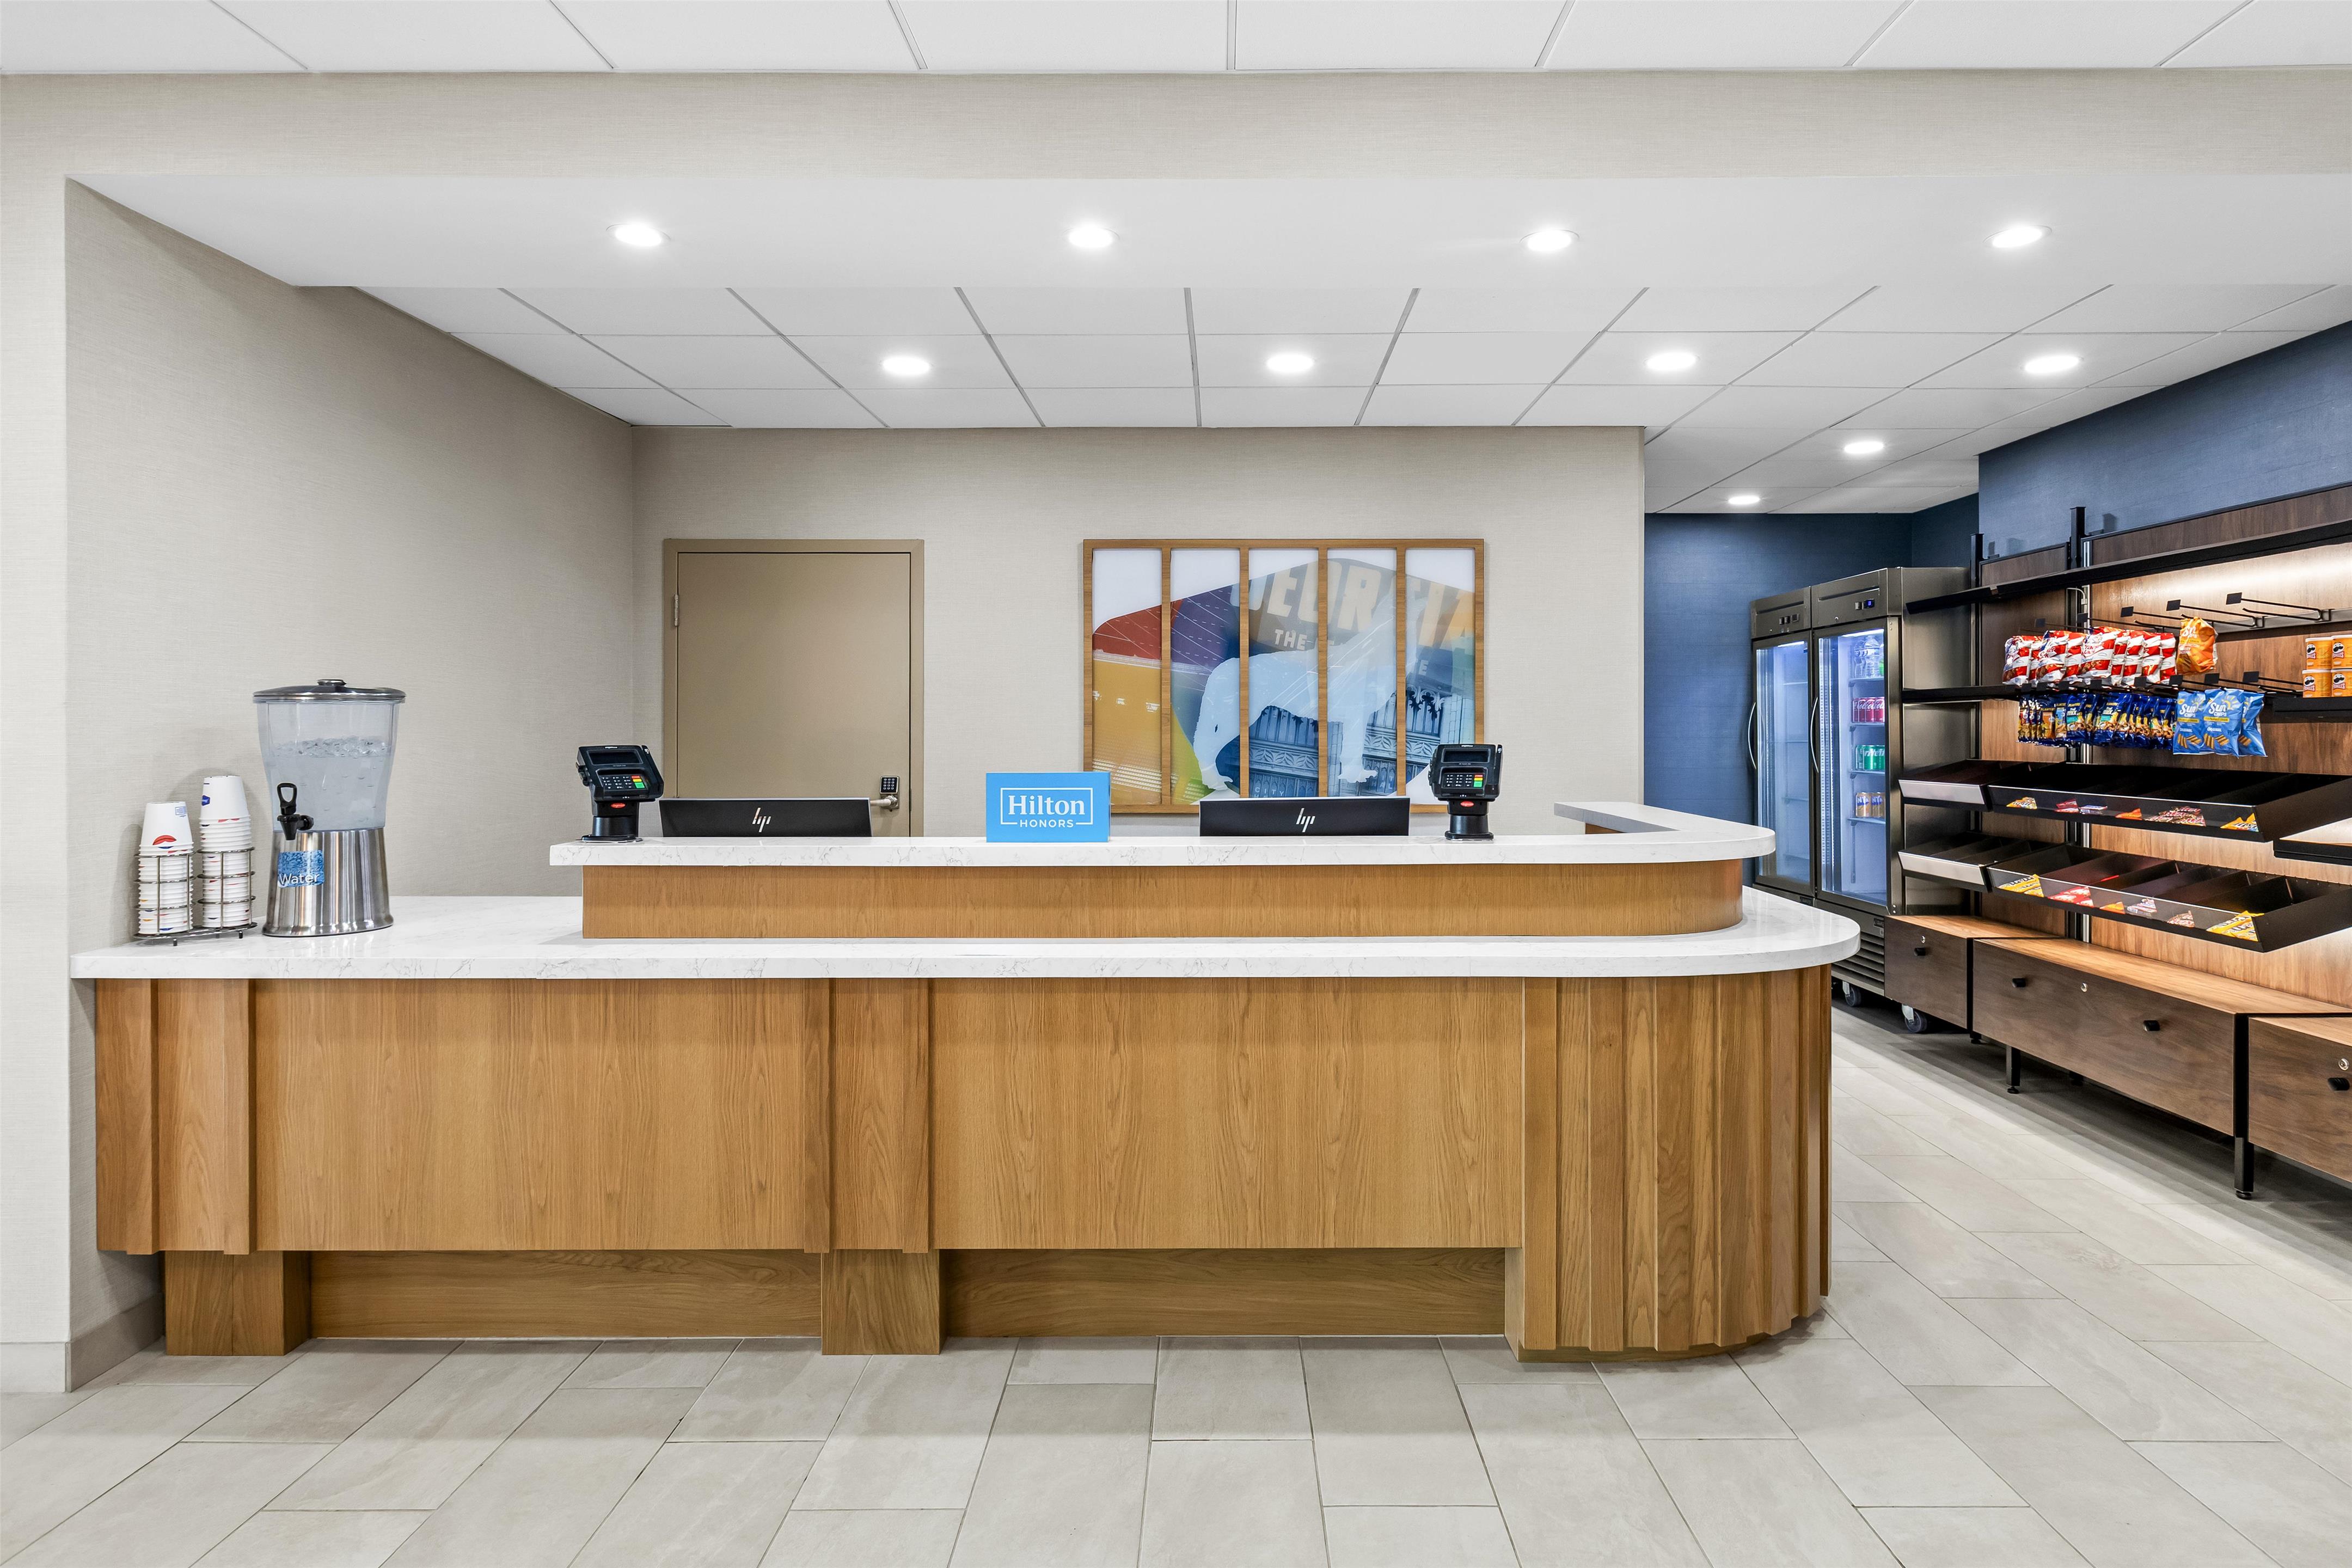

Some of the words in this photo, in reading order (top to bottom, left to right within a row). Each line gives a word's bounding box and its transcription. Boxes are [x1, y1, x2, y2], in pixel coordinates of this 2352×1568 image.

[2179, 704, 2196, 715] Sun
[2208, 702, 2226, 714] Sun
[1254, 787, 1284, 797] CITY
[1008, 795, 1085, 815] Hilton
[1020, 819, 1074, 828] HONORS
[279, 873, 320, 885] Water
